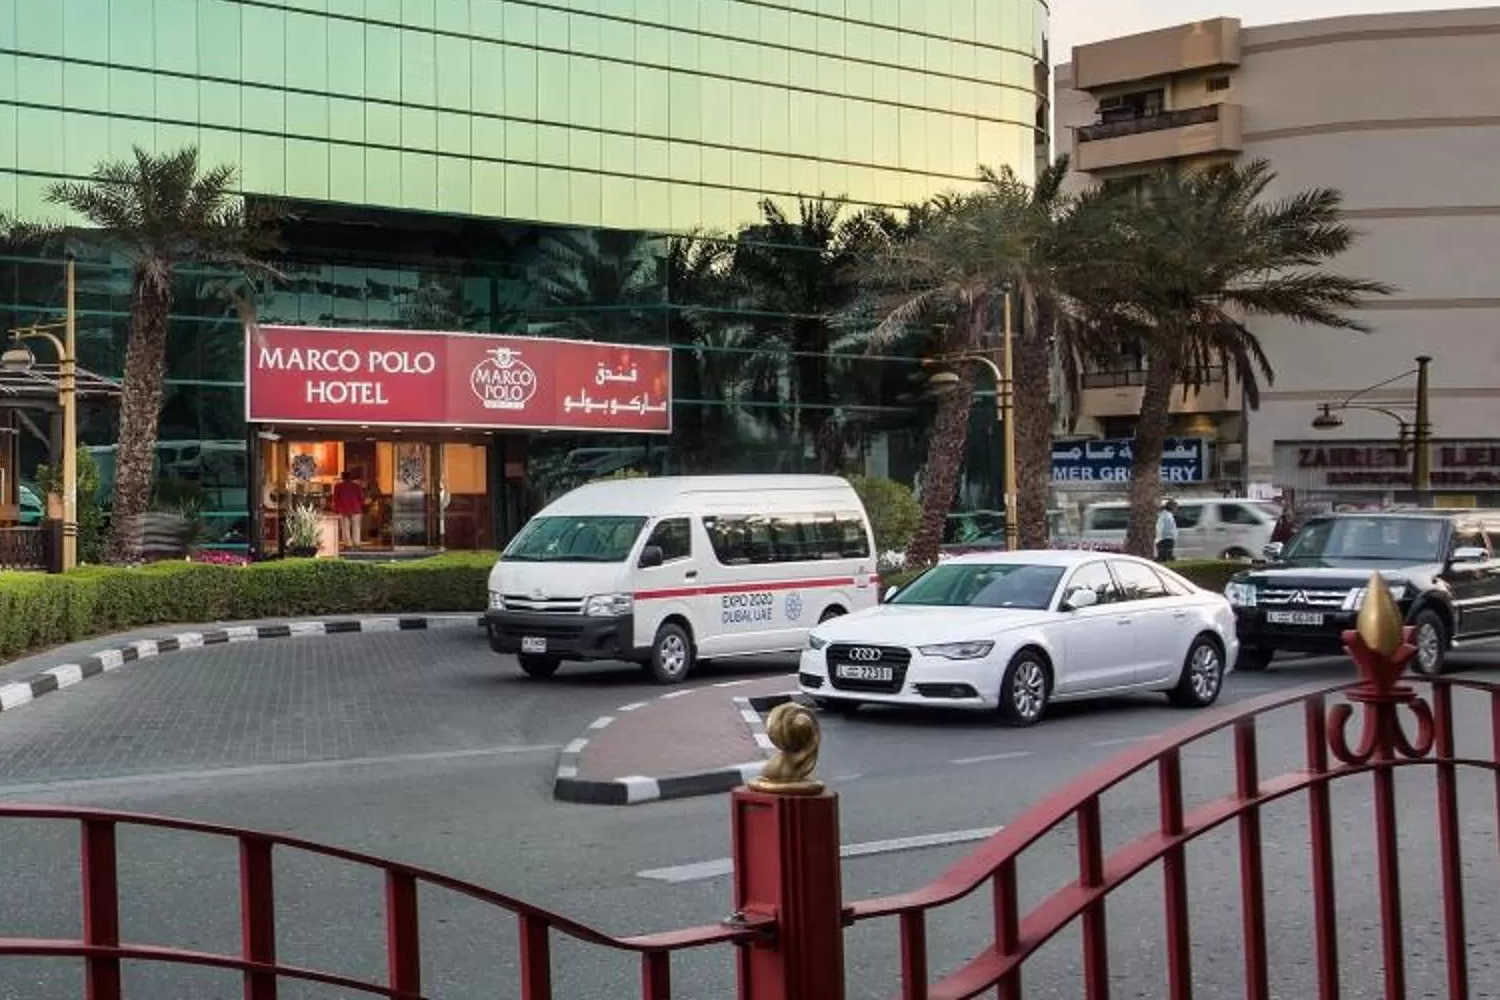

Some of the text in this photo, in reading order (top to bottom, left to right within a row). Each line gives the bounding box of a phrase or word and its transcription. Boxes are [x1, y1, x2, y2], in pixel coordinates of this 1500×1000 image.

[259, 347, 436, 374] MARCO POLO
[475, 368, 533, 386] MARCO
[595, 362, 638, 385] فندق
[306, 380, 389, 405] HOTEL
[485, 384, 524, 401] POLO
[563, 388, 667, 415] ماركو بولو
[1052, 466, 1198, 481] MER GRERY
[722, 591, 773, 608] EXPO 2020
[754, 607, 773, 621] UAE
